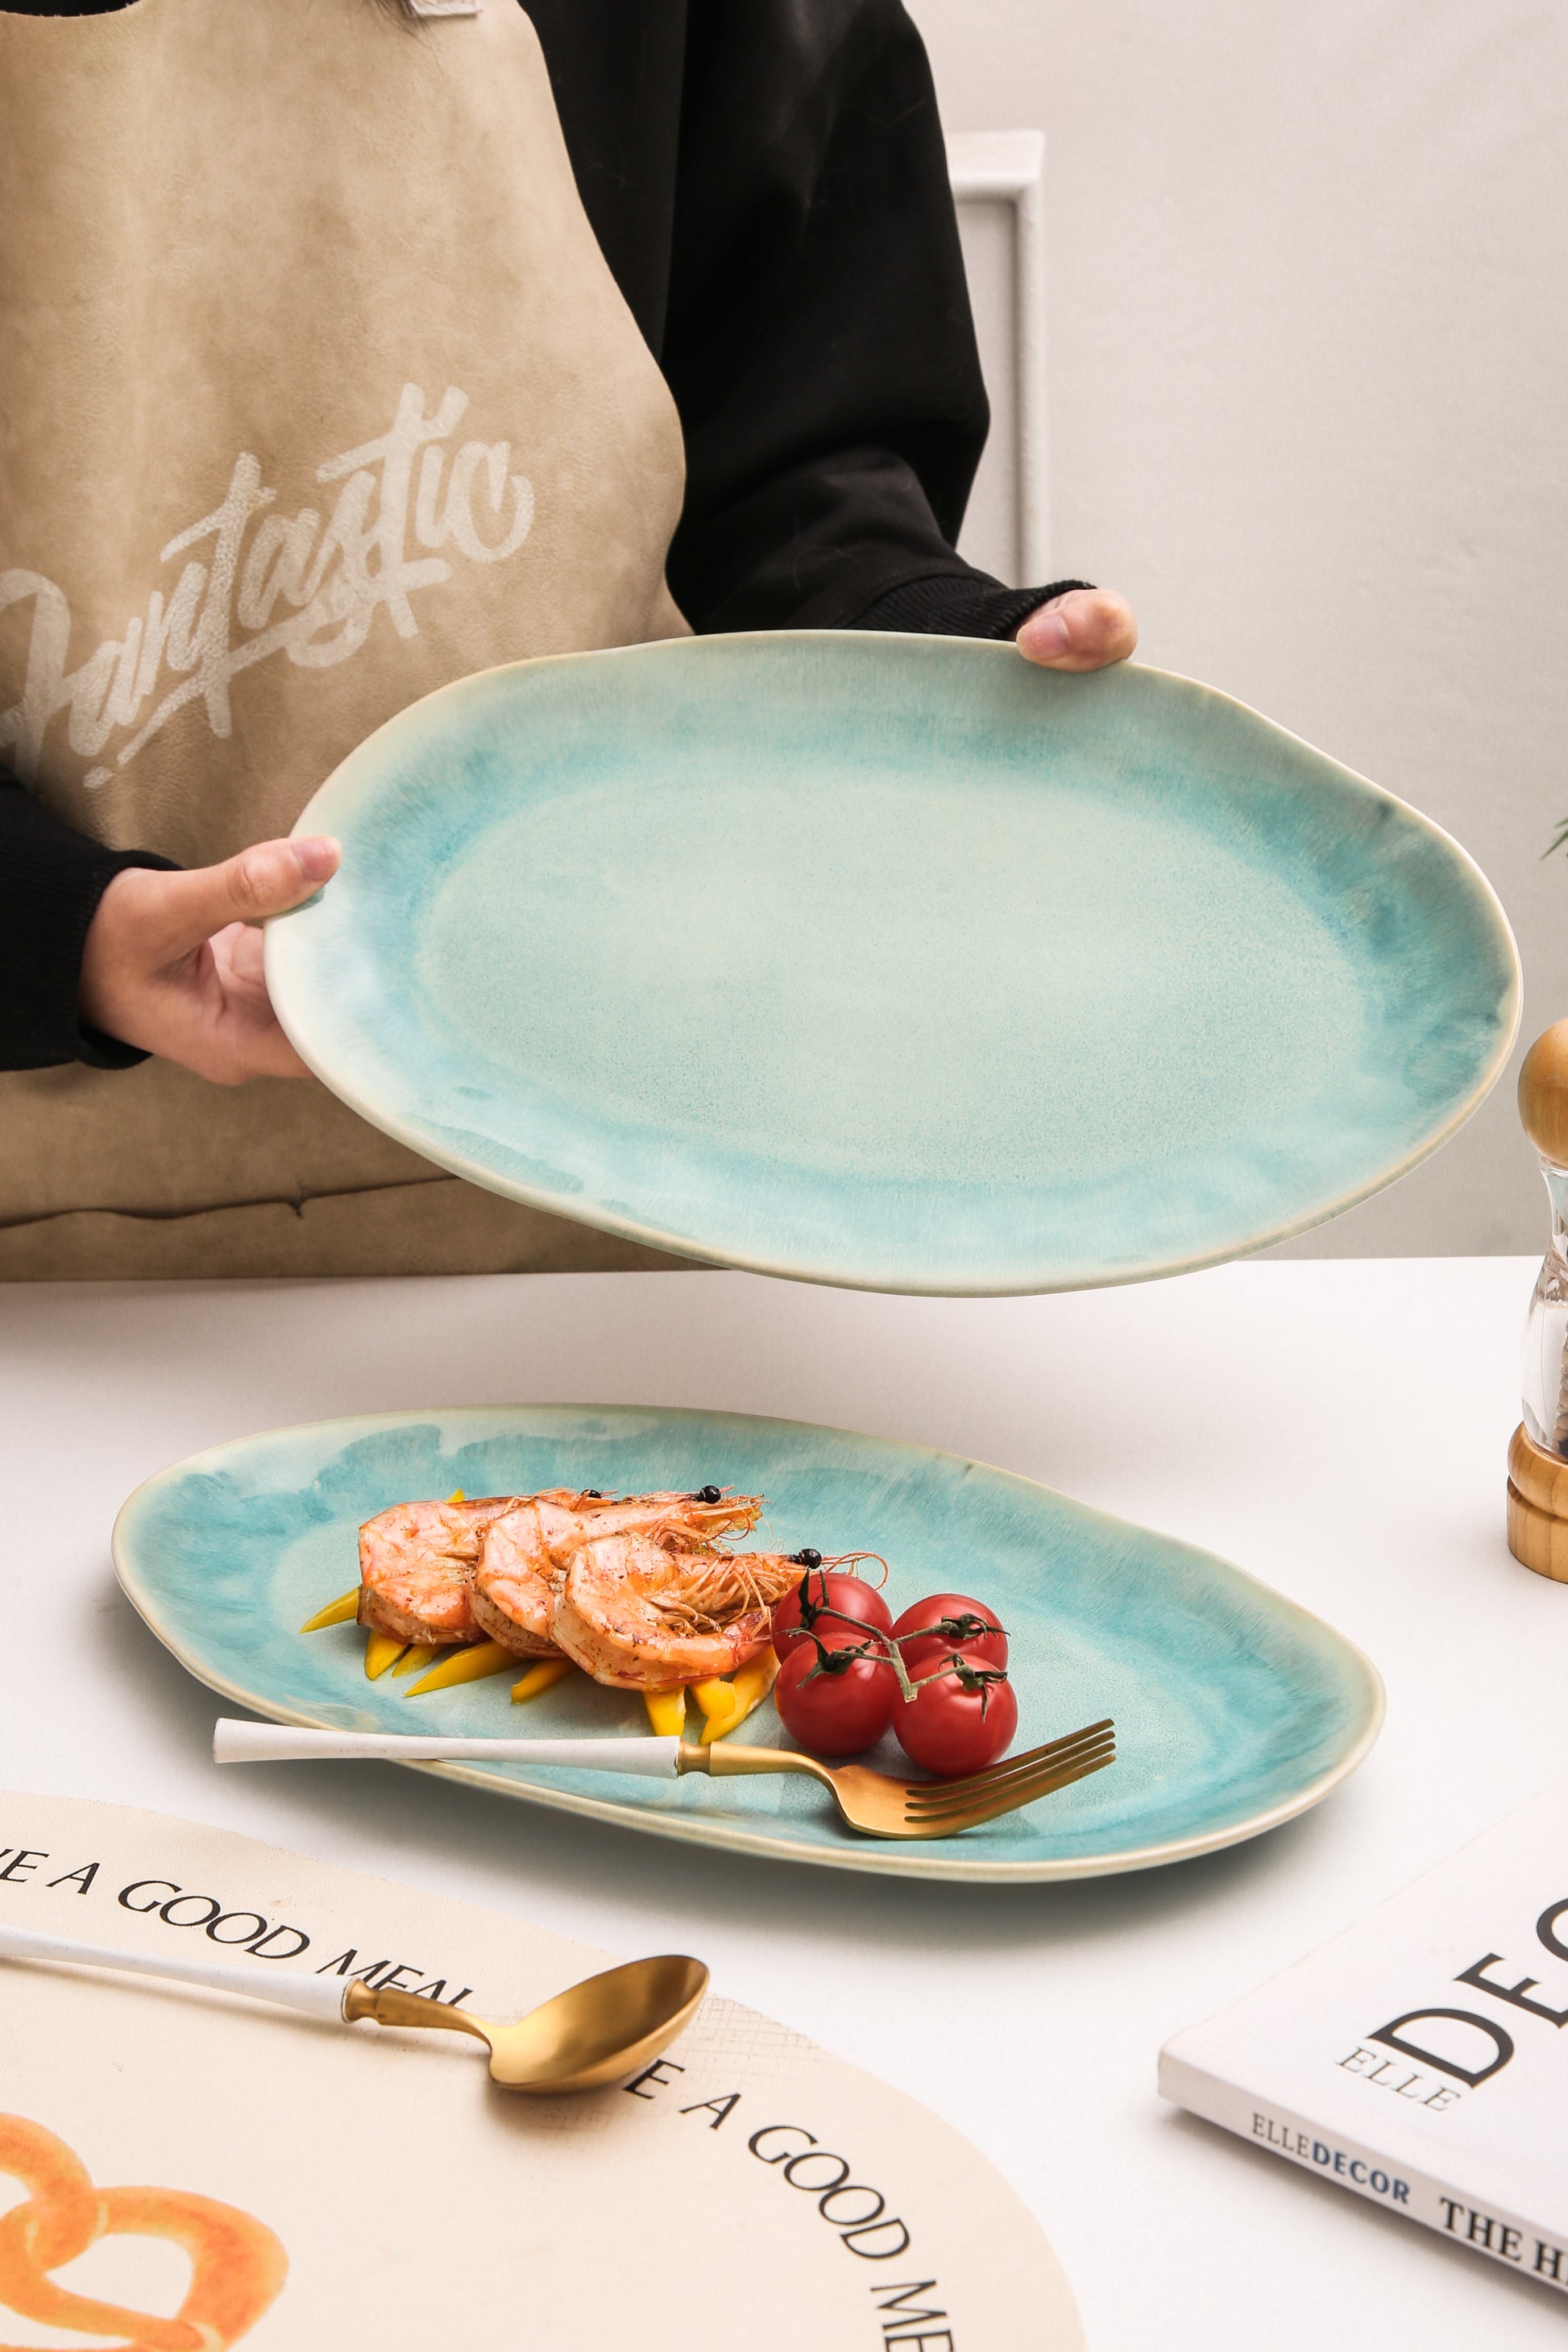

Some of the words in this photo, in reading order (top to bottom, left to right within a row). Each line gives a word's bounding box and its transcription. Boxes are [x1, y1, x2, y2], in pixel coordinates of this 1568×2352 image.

[0, 1848, 49, 1883] E
[45, 1862, 100, 1895] A
[118, 1880, 311, 1959] GOOD
[1366, 1897, 1568, 2089] DE
[1335, 2045, 1462, 2112] ELLE
[678, 2092, 741, 2130] A
[748, 2124, 911, 2260] GOOD
[1438, 2195, 1524, 2263] THE
[1533, 2238, 1568, 2288] H
